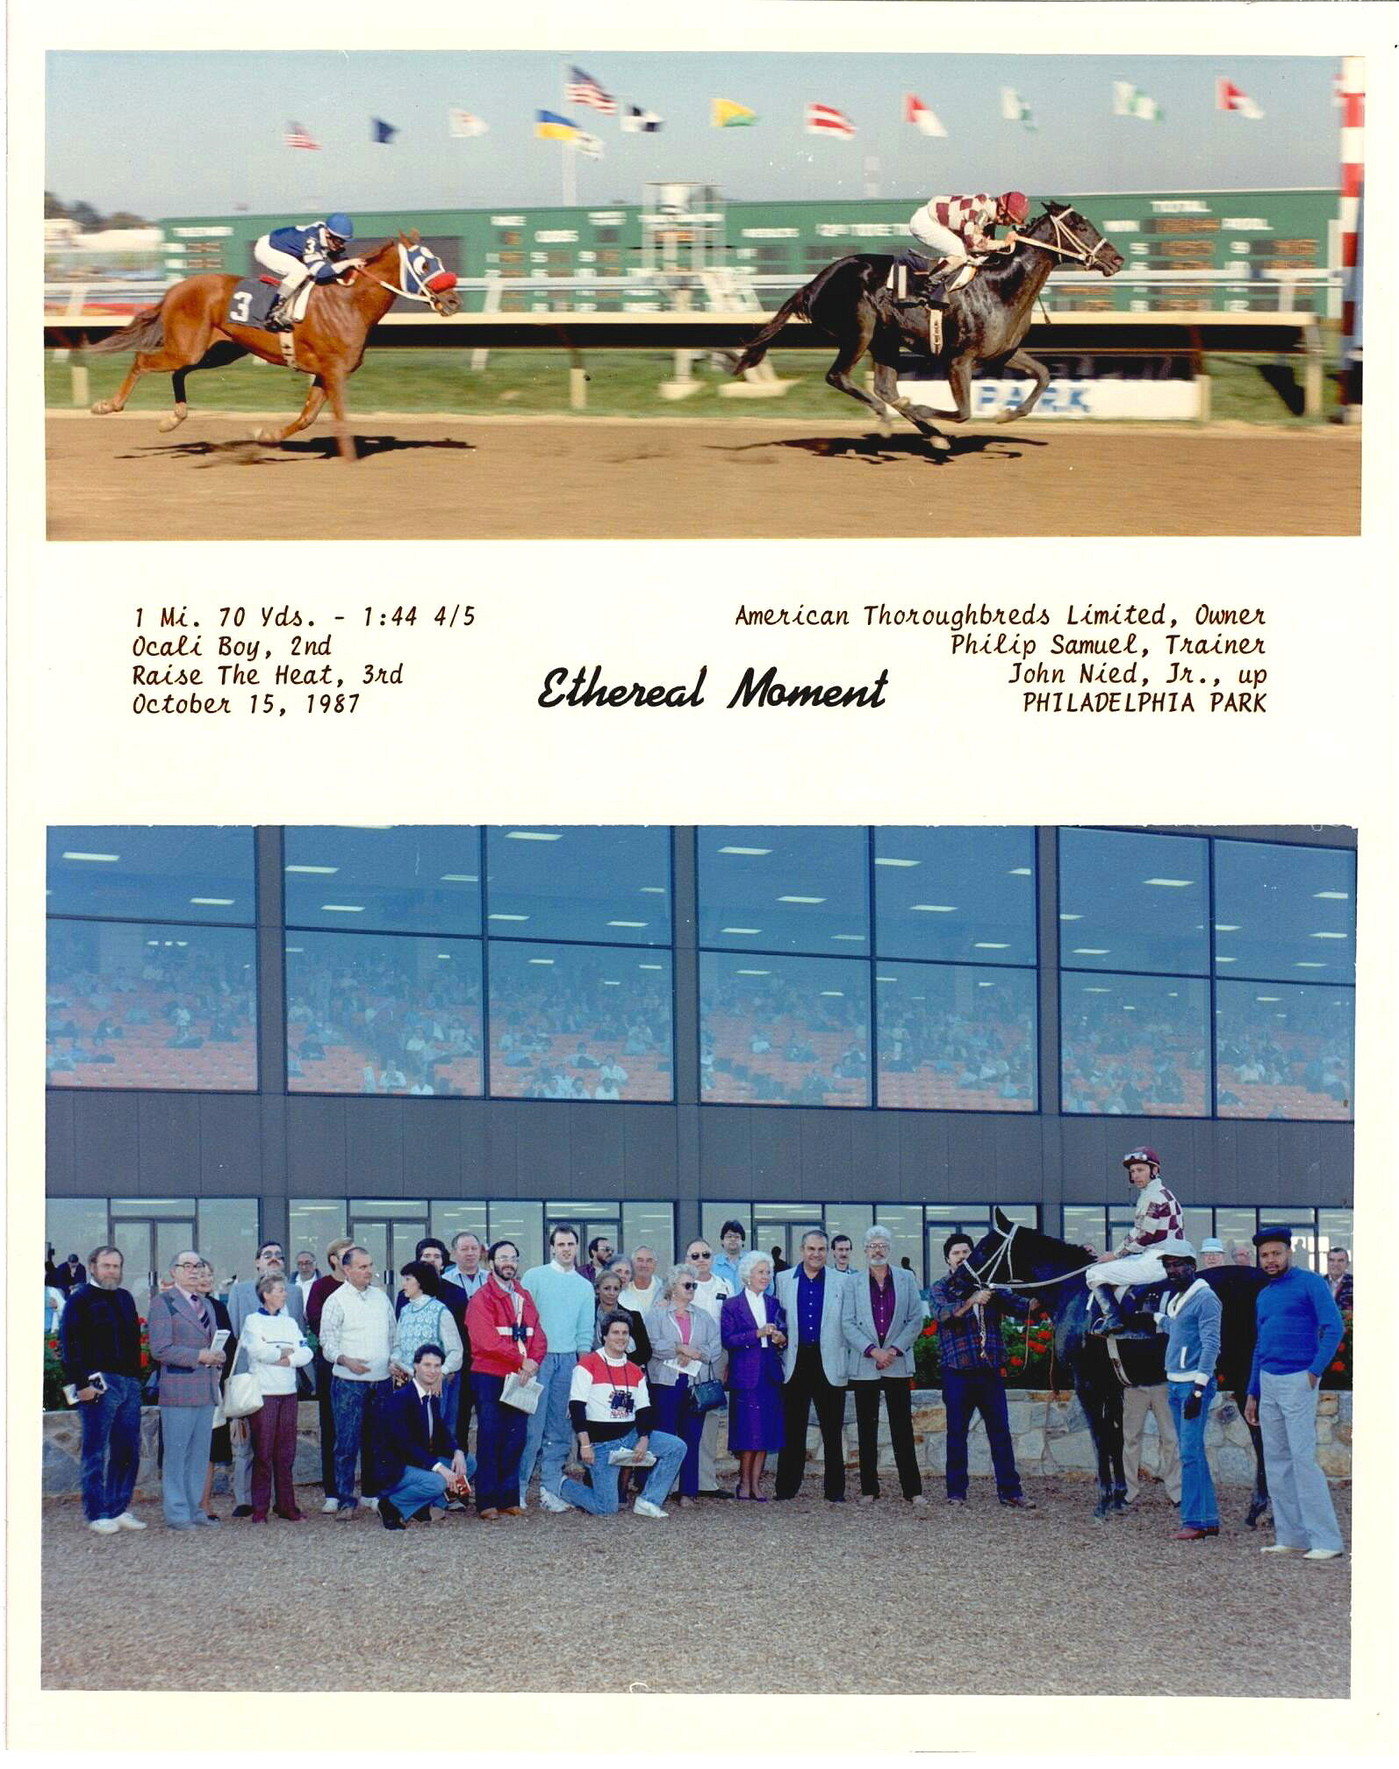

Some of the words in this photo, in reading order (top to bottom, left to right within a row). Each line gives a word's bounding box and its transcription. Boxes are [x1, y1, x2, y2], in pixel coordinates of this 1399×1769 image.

[304, 239, 316, 254] 3
[229, 290, 254, 322] 3
[978, 386, 1091, 414] PARK
